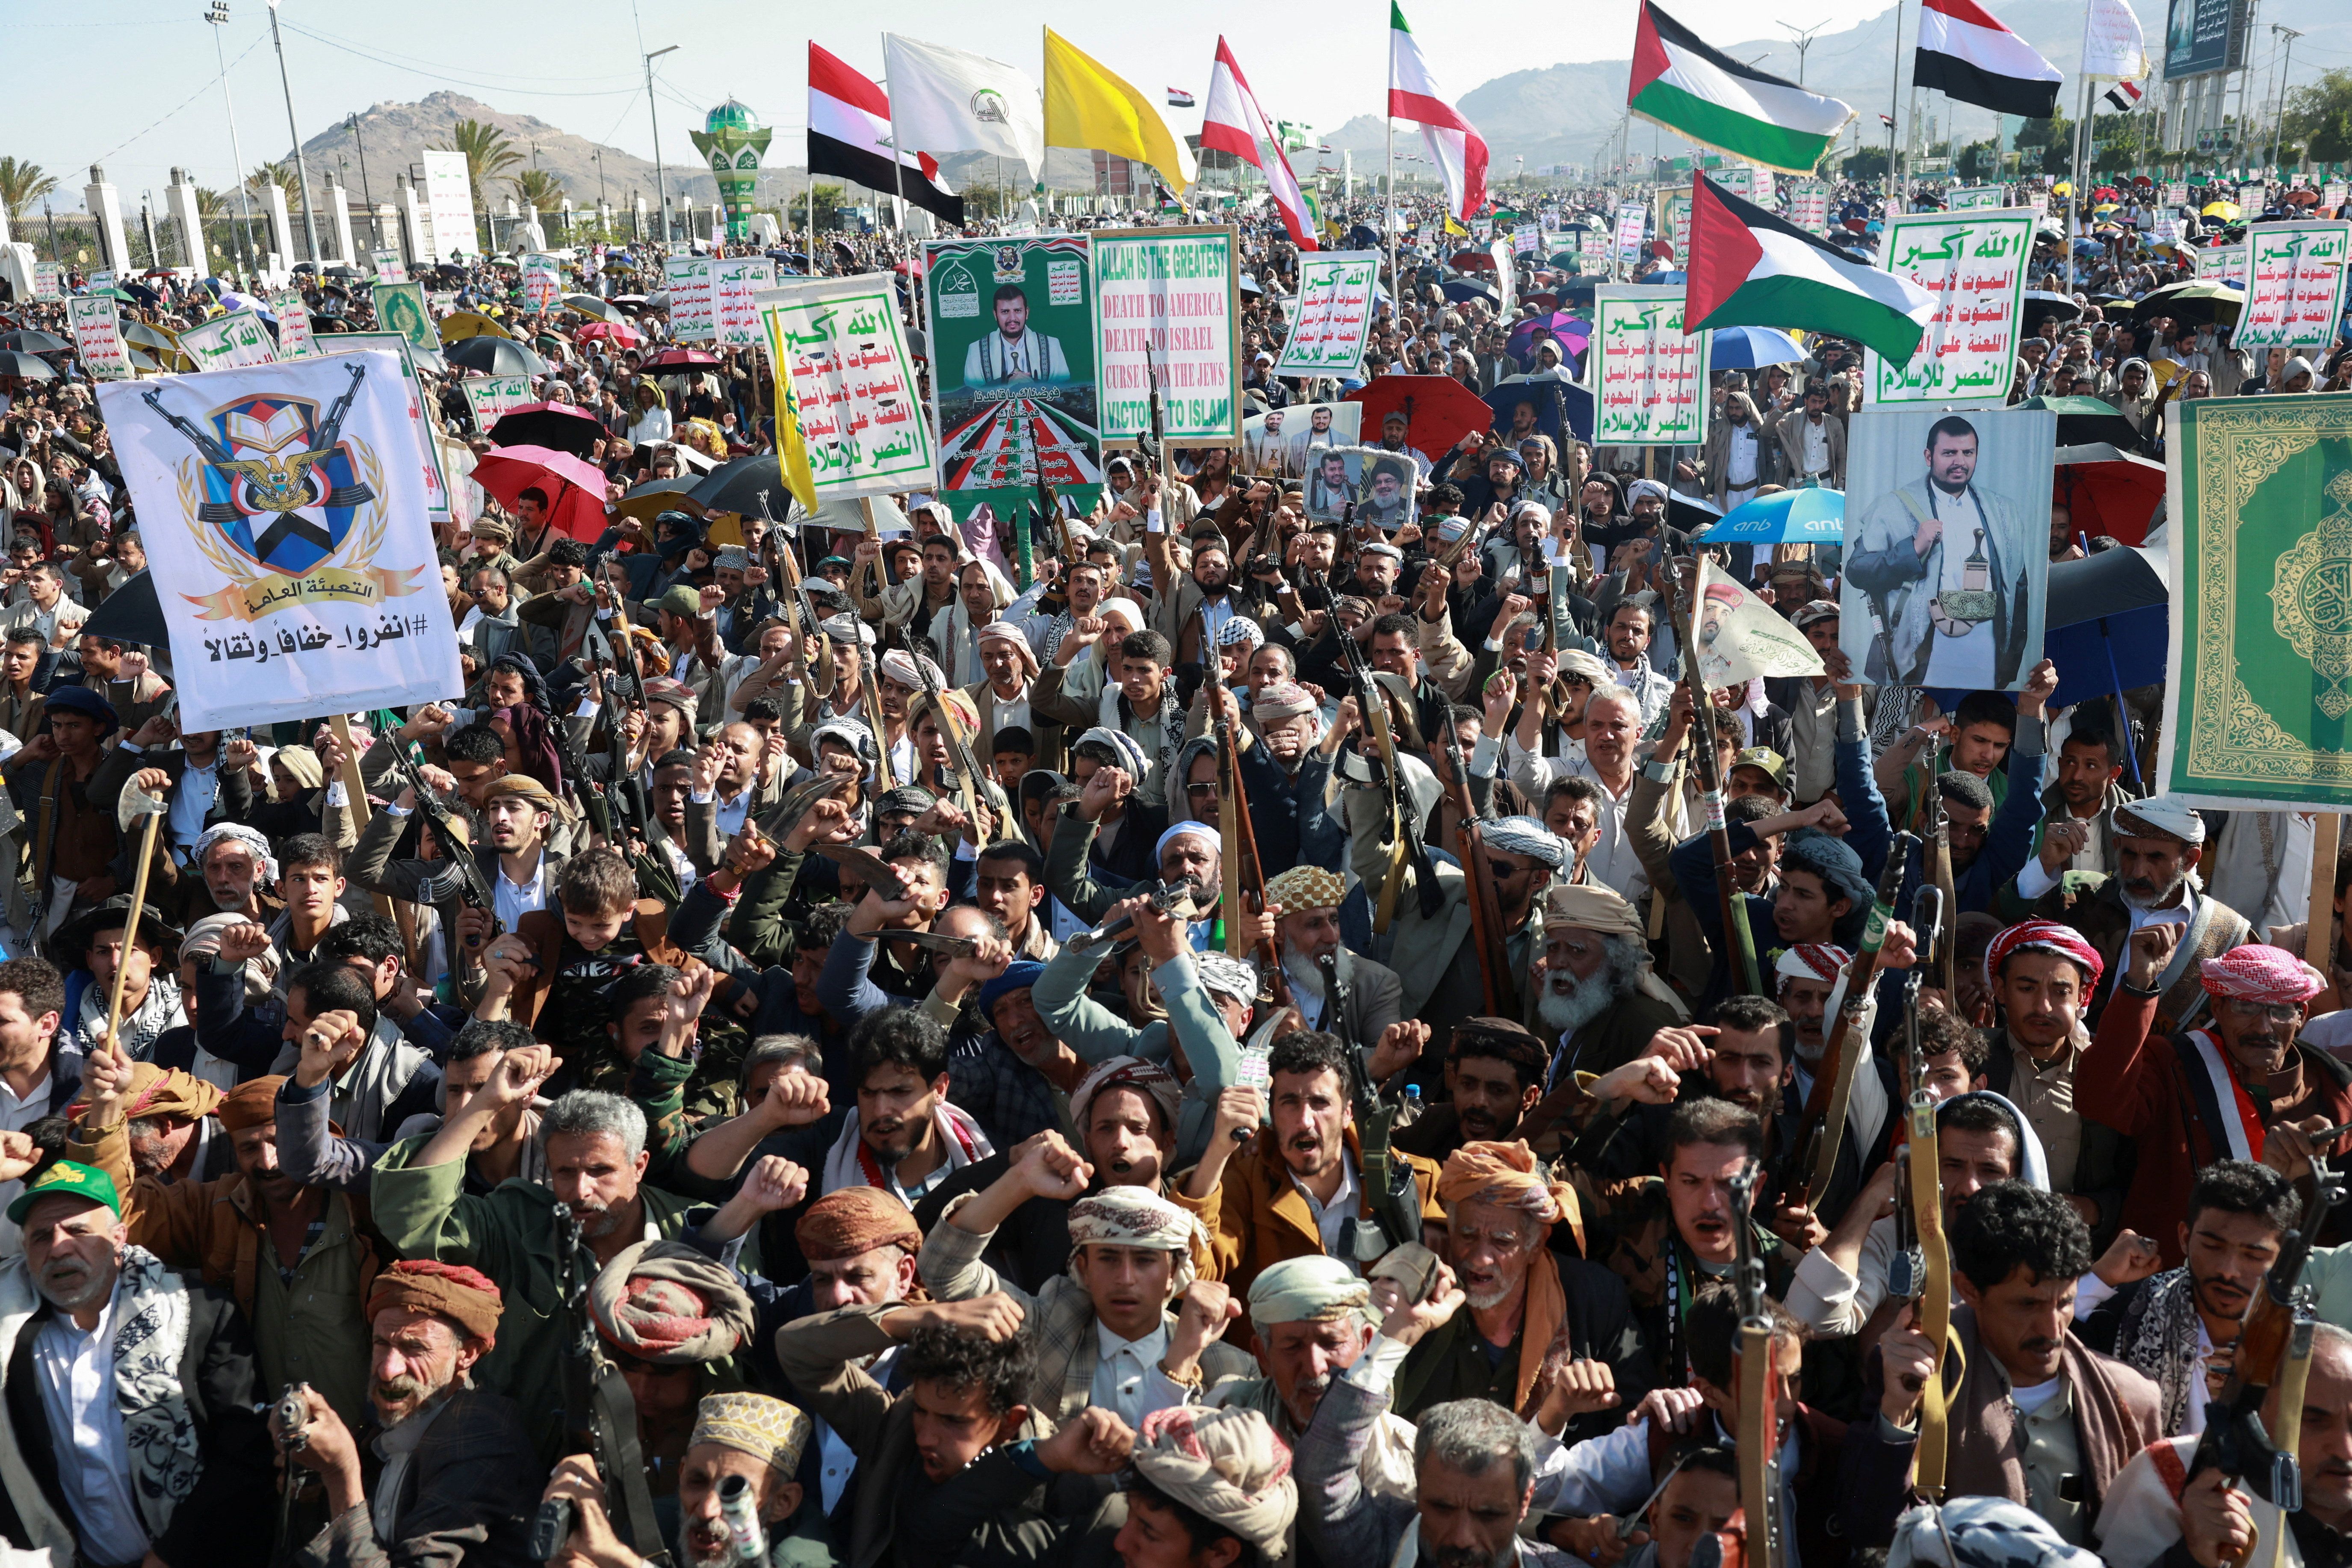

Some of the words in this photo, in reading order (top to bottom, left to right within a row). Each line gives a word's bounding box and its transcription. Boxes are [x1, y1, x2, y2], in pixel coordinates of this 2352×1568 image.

[1736, 173, 1749, 183] الله
[1955, 193, 1980, 210] أكبر
[1980, 193, 1998, 205] الله
[1895, 226, 1974, 270] أكبر
[1974, 228, 2020, 257] الله
[2257, 234, 2308, 265] أكبر
[2309, 236, 2342, 256] الله
[526, 257, 541, 270] أكبر
[542, 259, 555, 269] الله
[1050, 264, 1065, 273] أكبر
[1102, 246, 1133, 281] ALLAH
[1138, 246, 1146, 280] IS
[1149, 245, 1171, 279] THE
[1173, 243, 1226, 279] GREATEST
[2202, 255, 2228, 271] أكبر
[2231, 255, 2246, 265] الله
[668, 263, 698, 282] أكبر
[718, 264, 748, 285] أكبر
[750, 266, 768, 280] الله
[1306, 265, 1345, 292] أكبر
[1345, 267, 1370, 285] الله
[2201, 269, 2225, 280] لأمريكا
[2257, 263, 2297, 283] لأمريكا
[2301, 265, 2338, 282] الموت
[669, 281, 691, 292] لأمريكا
[947, 272, 971, 291] محمد
[1962, 269, 2013, 294] الموت
[290, 292, 300, 304] الله
[719, 285, 746, 298] لأمريكا
[1304, 289, 1335, 308] لأمريكا
[1338, 292, 1366, 307] الموت
[2254, 287, 2294, 305] لإسرائيل
[2298, 287, 2334, 304] الموت
[99, 301, 111, 315] الله
[672, 296, 694, 307] لإسرائيل
[720, 301, 748, 313] لإسرائيل
[1103, 293, 1145, 318] DEATH
[1149, 293, 1164, 317] TO
[1168, 292, 1223, 317] AMERICA
[77, 300, 95, 321] أكبر
[674, 310, 689, 320] اليهود
[691, 309, 700, 318] على
[1300, 310, 1332, 327] لإسرائيل
[1334, 311, 1364, 325] الموت
[1959, 301, 2010, 326] الموت
[2249, 309, 2278, 326] اليهود
[2281, 309, 2298, 325] على
[2302, 308, 2331, 322] اللعنة
[78, 319, 98, 332] لأمريكا
[99, 320, 113, 331] الموت
[675, 319, 698, 334] للإسلام
[722, 316, 740, 329] اليهود
[743, 316, 753, 327] على
[848, 307, 887, 335] الله
[1605, 303, 1664, 338] أكبر
[103, 334, 115, 345] الموت
[239, 320, 264, 345] الله
[724, 330, 749, 345] للإسلام
[784, 307, 839, 355] أكبر
[1105, 328, 1146, 352] DEATH
[1149, 327, 1165, 351] TO
[1169, 327, 1214, 351] ISRAEL
[1294, 330, 1319, 344] اليهود
[1319, 329, 1334, 343] على
[1337, 329, 1360, 341] اللعنة
[2241, 329, 2286, 350] للإسلام
[2287, 326, 2327, 348] النصر
[82, 334, 101, 347] لإسرائيل
[199, 322, 237, 366] أكبر
[1606, 336, 1655, 358] لأمريكا
[1659, 339, 1699, 358] الموت
[1935, 335, 1960, 358] على
[1968, 333, 2007, 352] اللعنة
[86, 349, 101, 360] اليهود
[847, 344, 897, 370] الموت
[1286, 345, 1323, 364] للإسلام
[1323, 345, 1357, 363] النصر
[91, 362, 112, 376] للإسلام
[1106, 364, 1139, 389] CURSE
[1173, 363, 1194, 387] THE
[1197, 362, 1225, 387] JEWS
[1605, 364, 1654, 384] لإسرائيل
[1658, 364, 1698, 384] الموت
[1948, 360, 2003, 394] النصر
[506, 379, 527, 396] الله
[855, 373, 904, 400] الموت
[1884, 362, 1945, 396] للإسلام
[473, 378, 502, 402] أكبر
[797, 382, 851, 412] لإسرائيل
[974, 389, 1007, 403] قائدنا
[1008, 390, 1016, 403] يا
[1016, 386, 1060, 401] فوضناك
[1604, 389, 1638, 408] اليهود
[1642, 389, 1661, 408] على
[1666, 388, 1696, 405] اللعنة
[476, 400, 502, 417] لأمريكا
[873, 401, 912, 425] اللعنة
[996, 407, 1040, 420] فوضناك
[1167, 399, 1185, 428] TO
[1189, 399, 1228, 427] ISLAM
[803, 413, 841, 441] اليهود
[846, 410, 869, 436] على
[1603, 412, 1651, 439] للإسلام
[1653, 409, 1695, 437] النصر
[1002, 431, 1025, 440] ونبارك
[869, 429, 919, 469] النصر
[1042, 445, 1056, 453] السيد
[1057, 444, 1074, 452] الثورة
[1074, 442, 1087, 450] لقائد
[809, 439, 862, 476] للإسلام
[953, 450, 975, 461] الحوثي
[996, 463, 1017, 472] الشريف
[1017, 461, 1034, 471] النبوي
[974, 480, 999, 489] والتسليم
[999, 478, 1016, 487] الصلاة
[1016, 476, 1031, 485] أفضل
[1733, 519, 1771, 532] anb
[1805, 518, 1844, 531] anb
[306, 577, 372, 598] التعبئة
[244, 582, 302, 614] العامة
